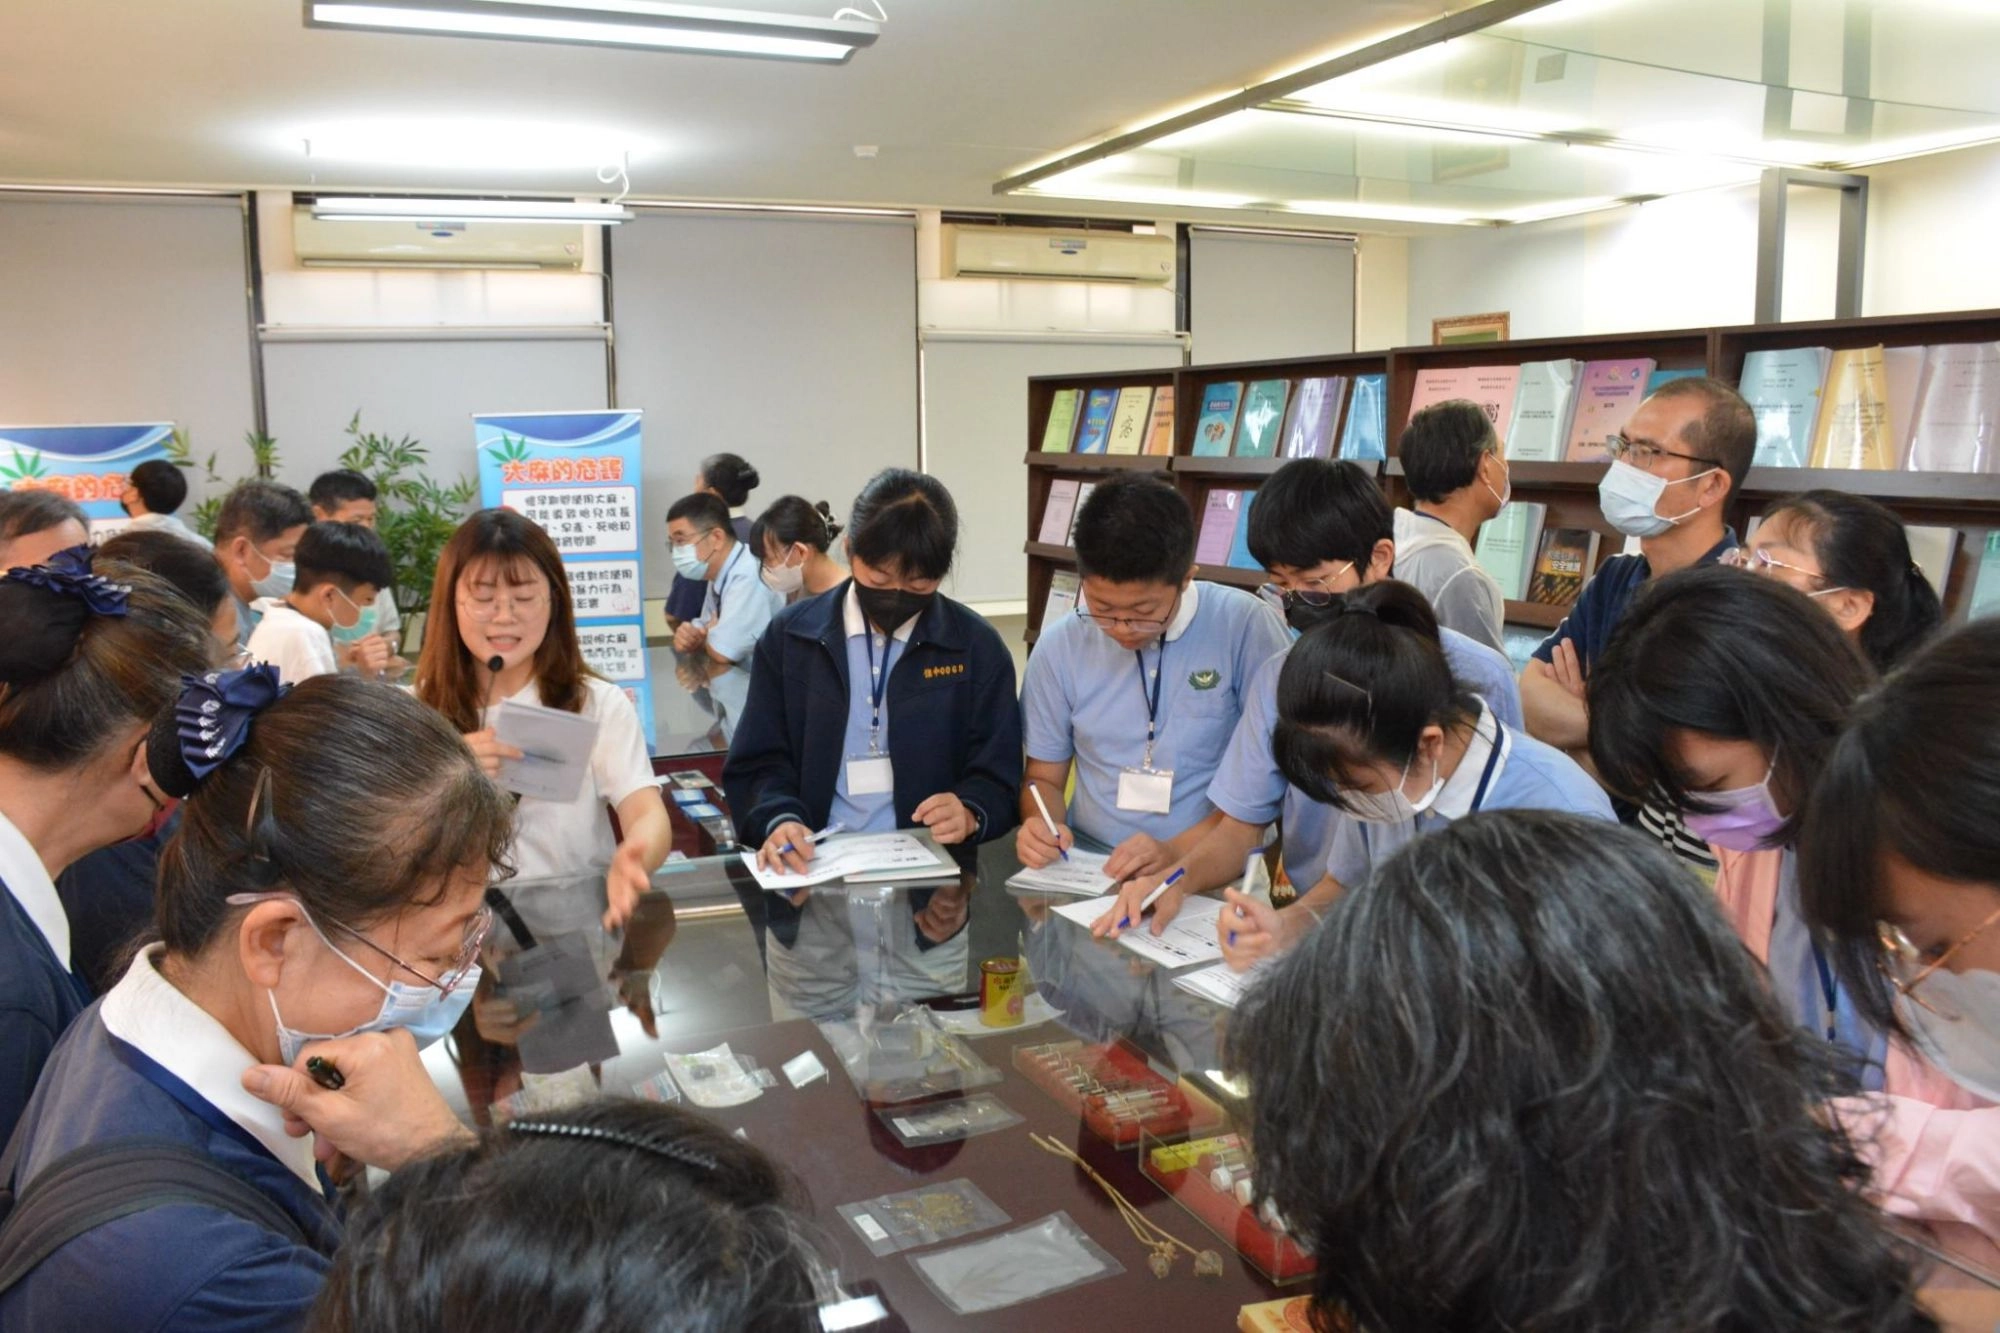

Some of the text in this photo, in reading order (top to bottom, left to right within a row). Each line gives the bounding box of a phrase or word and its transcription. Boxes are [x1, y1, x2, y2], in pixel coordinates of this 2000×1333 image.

[502, 457, 624, 484] 大麻的危害
